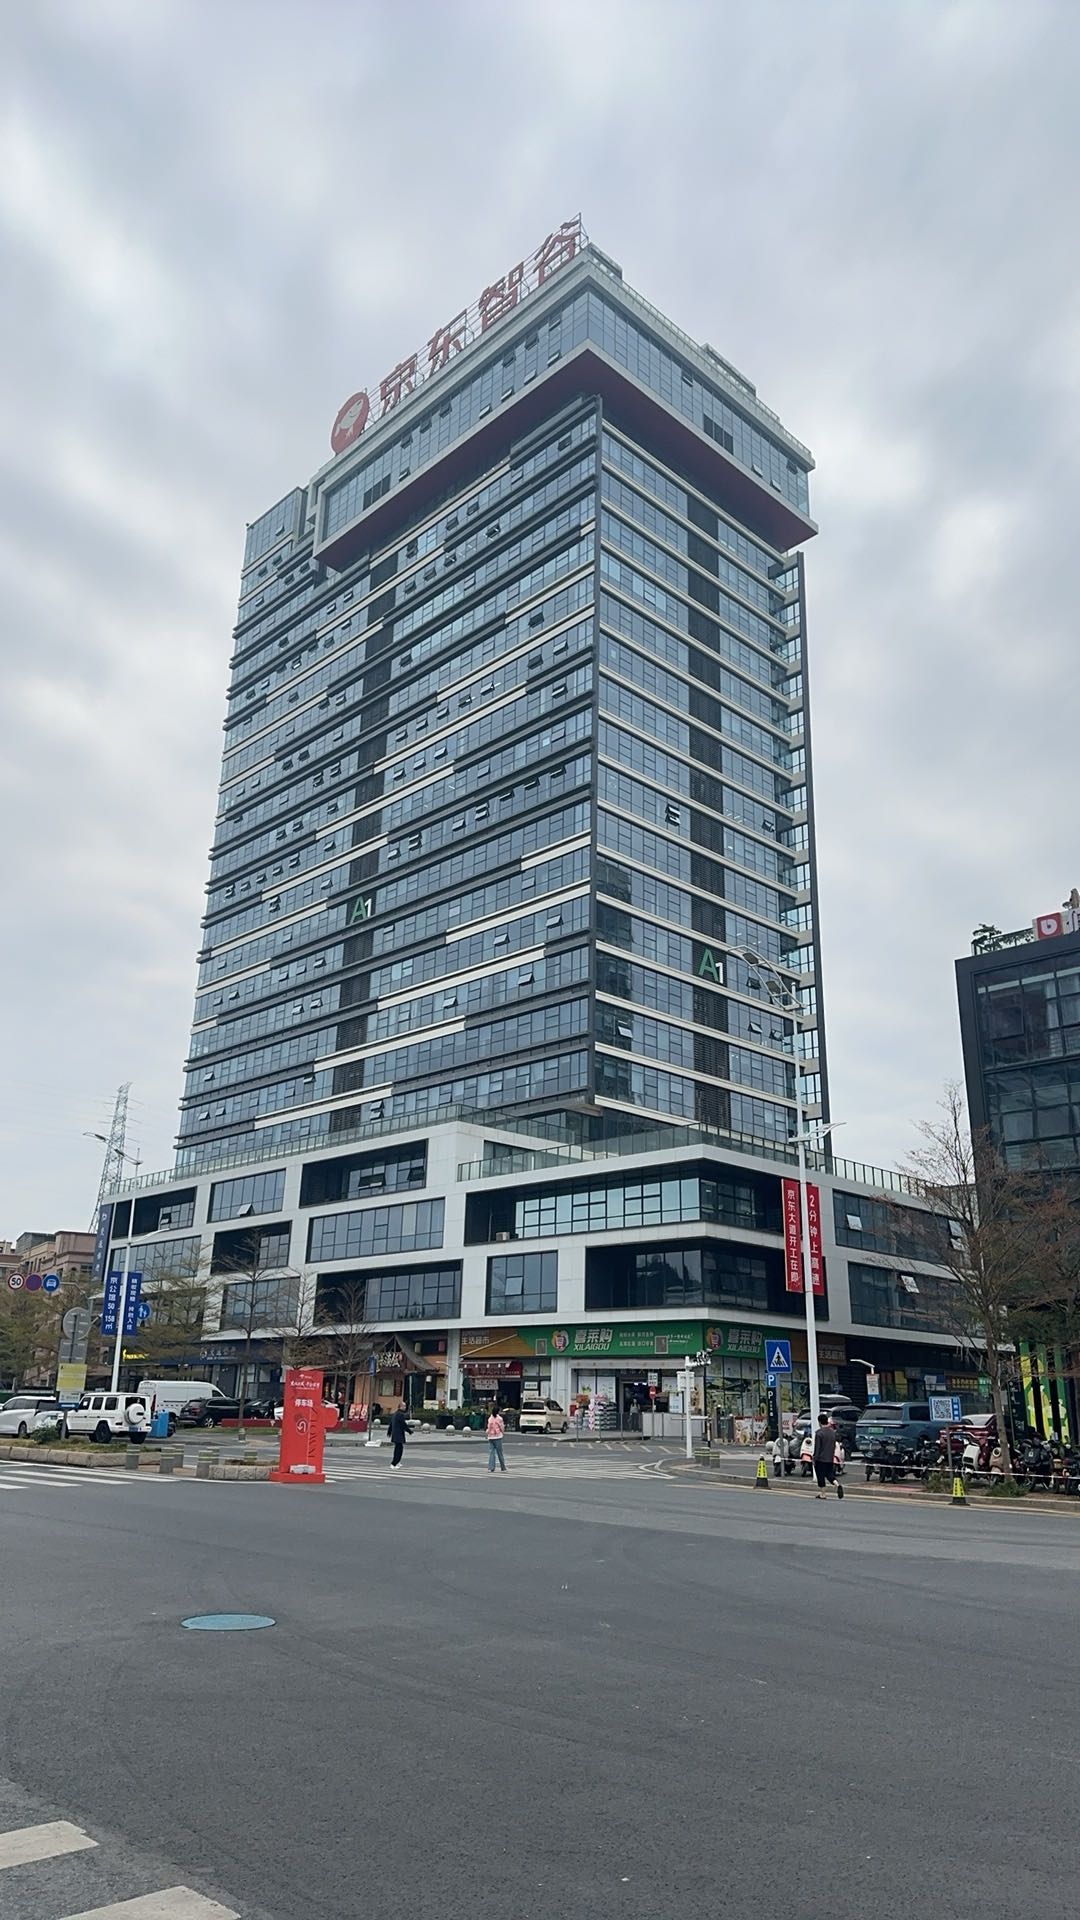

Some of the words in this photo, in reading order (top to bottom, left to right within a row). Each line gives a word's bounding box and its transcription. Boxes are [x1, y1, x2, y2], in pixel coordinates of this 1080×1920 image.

[379, 219, 580, 417] 京东智谷
[350, 896, 372, 924] A1
[699, 949, 723, 984] A1
[787, 1189, 799, 1282] 京东大道开工在即
[11, 1277, 22, 1286] 50
[573, 1343, 610, 1351] XILAIGOU
[574, 1329, 613, 1344] 喜莱购
[767, 1374, 775, 1386] P
